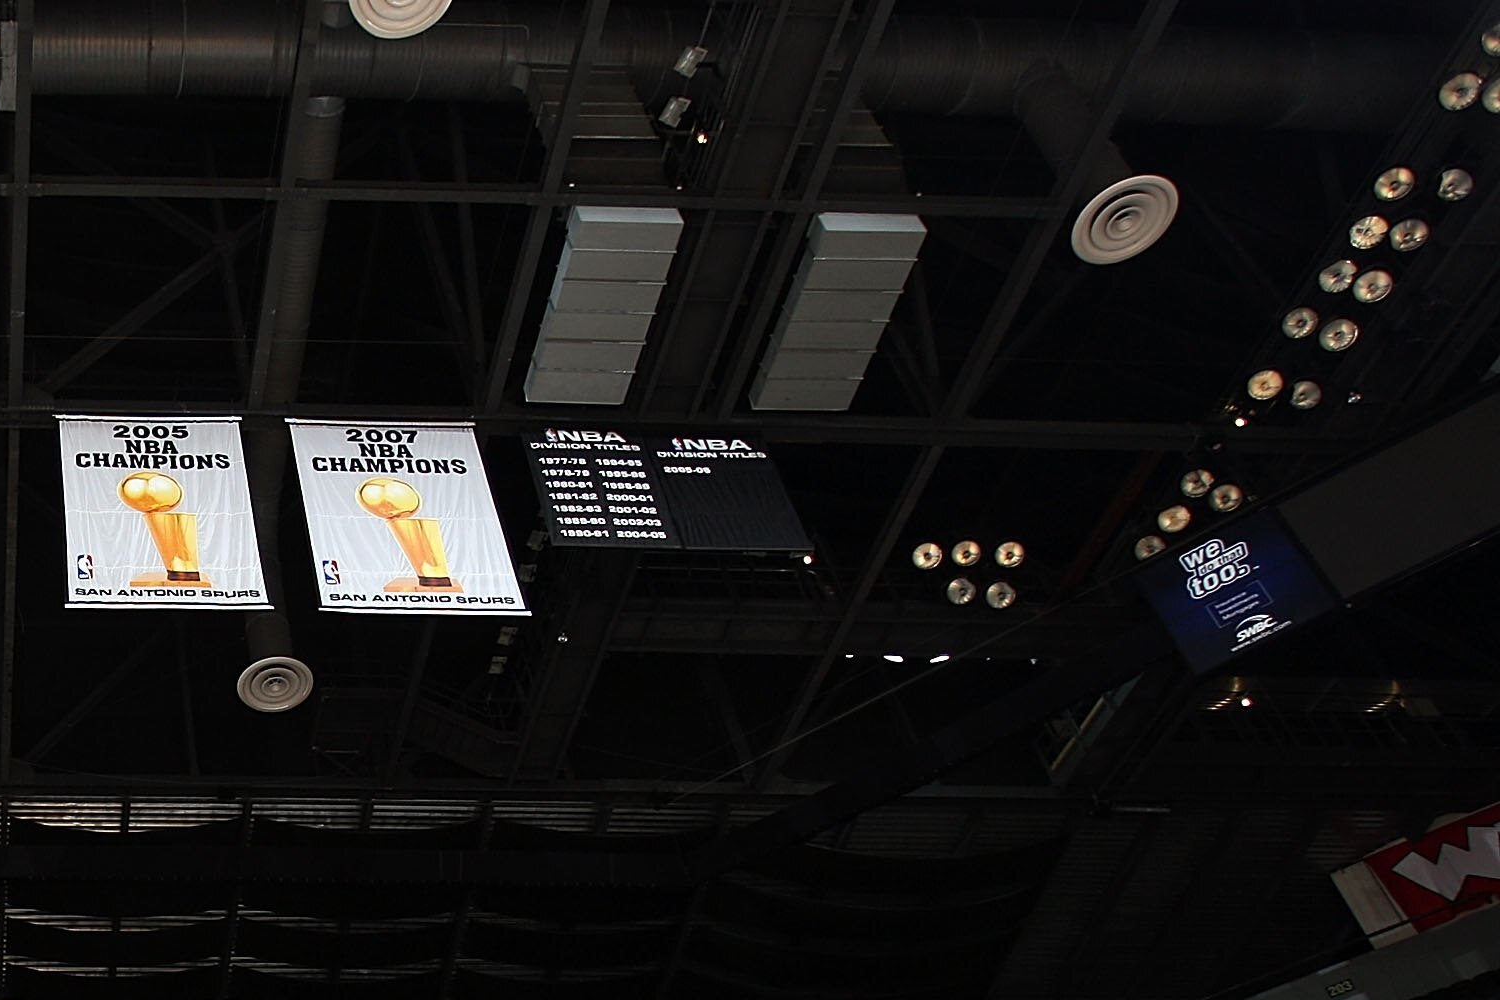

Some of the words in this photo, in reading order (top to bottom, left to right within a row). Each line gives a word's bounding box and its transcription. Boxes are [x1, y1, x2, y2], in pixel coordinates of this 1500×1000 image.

[113, 425, 189, 438] 2005
[345, 429, 418, 443] 2007
[557, 430, 626, 443] NBA
[125, 440, 179, 454] NBA
[530, 442, 591, 450] DIVISION
[594, 443, 641, 451] TITLES
[682, 438, 752, 450] NBA
[358, 444, 414, 458] NBA
[657, 451, 717, 459] DIVISION
[75, 453, 230, 469] CHAMPIONS
[312, 457, 467, 474] CHAMPIONS
[606, 494, 654, 502] 2000-01
[608, 506, 657, 514] 2001-02
[612, 518, 662, 526] 2002-03
[1184, 542, 1220, 568] we
[1199, 563, 1214, 575] do
[1220, 545, 1244, 565] that
[1191, 564, 1246, 596] too.
[75, 588, 112, 596] SAN
[117, 589, 197, 597] ANTONIO
[201, 590, 260, 598] SPURS
[329, 593, 366, 601] SAN
[372, 595, 452, 603] ANTONIO
[456, 596, 515, 605] SPURS
[1236, 617, 1278, 642] SWBC
[1327, 980, 1353, 996] 203
